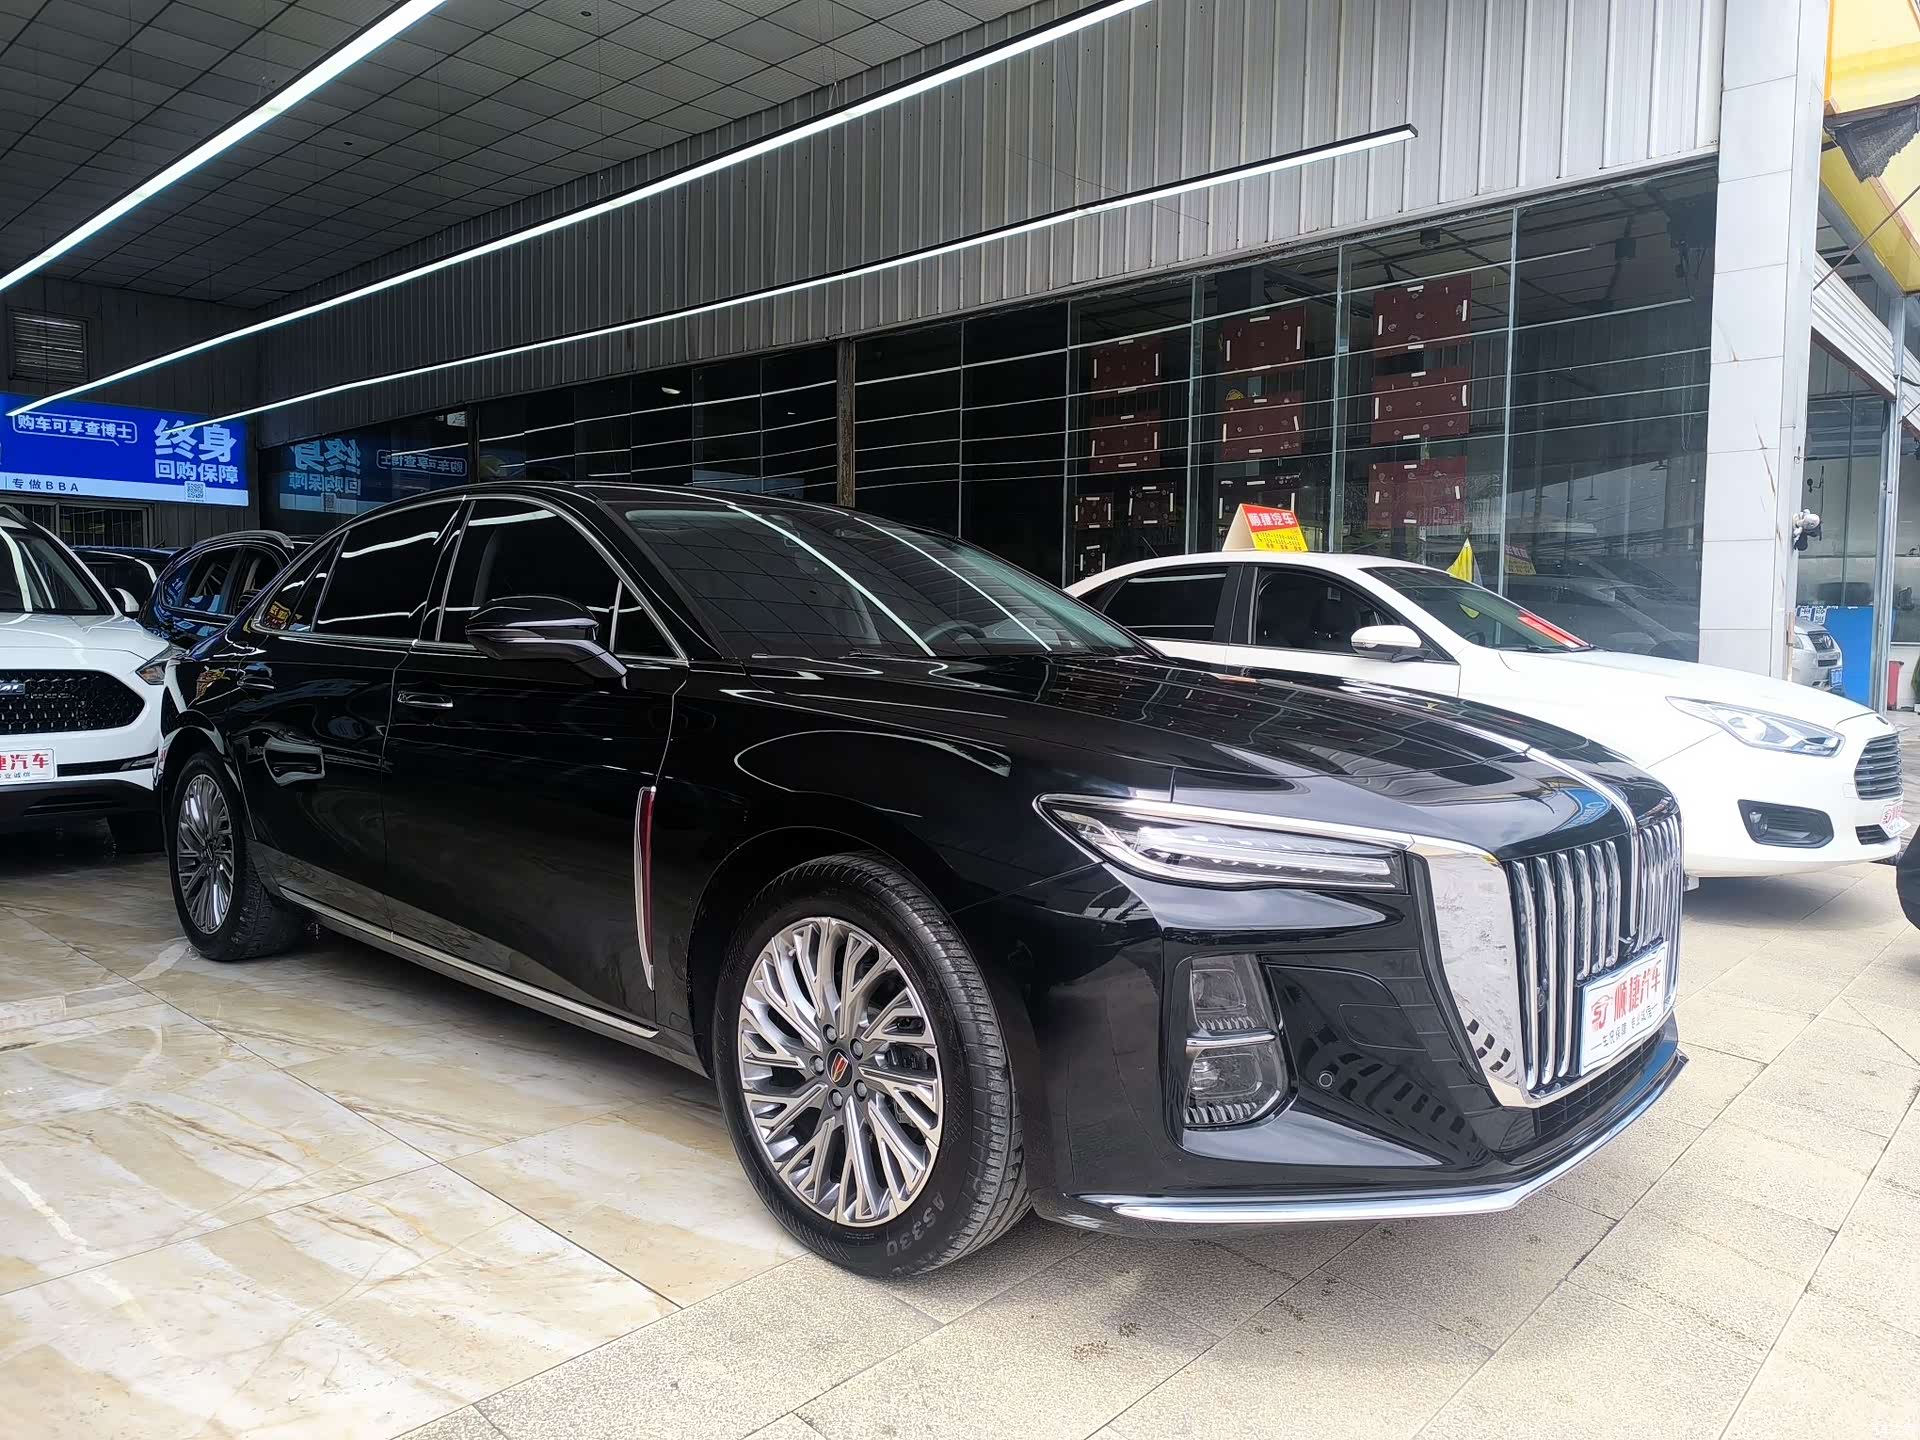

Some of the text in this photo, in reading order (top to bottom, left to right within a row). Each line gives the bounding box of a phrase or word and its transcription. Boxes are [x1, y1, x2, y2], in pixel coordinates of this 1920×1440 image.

[17, 414, 134, 440] 购车可享查博士
[153, 418, 238, 463] 终身
[154, 458, 239, 485] 回购保障
[1613, 959, 1662, 1023] 顺捷汽车
